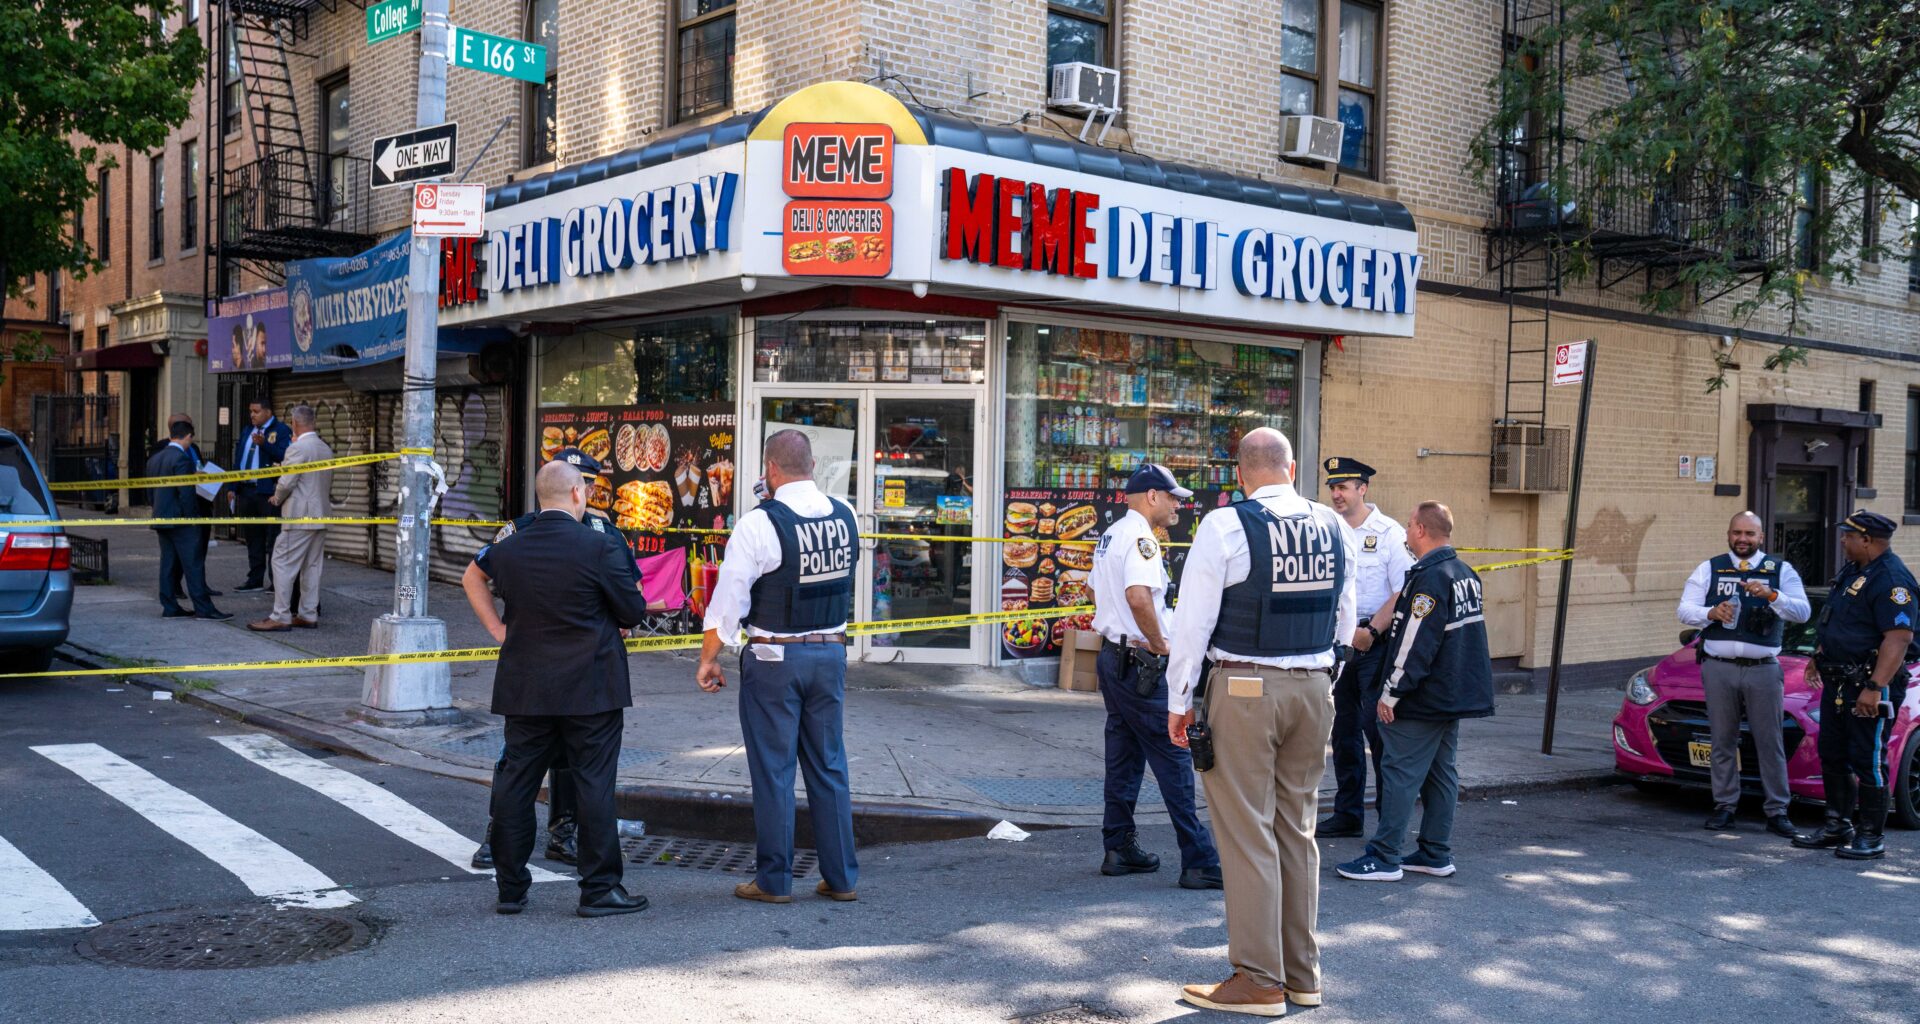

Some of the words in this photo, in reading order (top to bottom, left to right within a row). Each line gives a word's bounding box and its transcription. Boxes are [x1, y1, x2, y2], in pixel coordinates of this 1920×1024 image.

[374, 5, 408, 35] College
[462, 35, 474, 64] E
[483, 39, 515, 72] 166
[523, 46, 536, 64] St
[396, 146, 419, 168] ONE
[423, 140, 447, 163] WAY
[790, 135, 885, 184] MEME
[440, 190, 460, 198] Tuesday
[491, 217, 560, 293] DELI
[562, 172, 738, 277] GROCERY
[792, 208, 815, 232] DELI
[816, 209, 824, 232] &
[826, 208, 883, 233] GROCERIES
[940, 167, 1099, 279] MEME
[1109, 206, 1219, 290] DELI
[1233, 227, 1424, 314] GROCERY
[314, 291, 345, 330] MULTI
[348, 274, 410, 324] SERVICES
[586, 412, 608, 422] LUNCH
[623, 411, 644, 421] HALAL
[646, 410, 664, 420] FOOD
[672, 415, 699, 427] FRESH
[702, 414, 736, 426] COFFEE
[1010, 490, 1052, 499] BREAKFAST
[1067, 491, 1095, 500] LUNCH
[638, 536, 666, 553] SIDE
[794, 518, 850, 552] NYPD
[1267, 518, 1332, 555] NYPD
[799, 547, 852, 575] POLICE
[1272, 553, 1335, 582] POLICE
